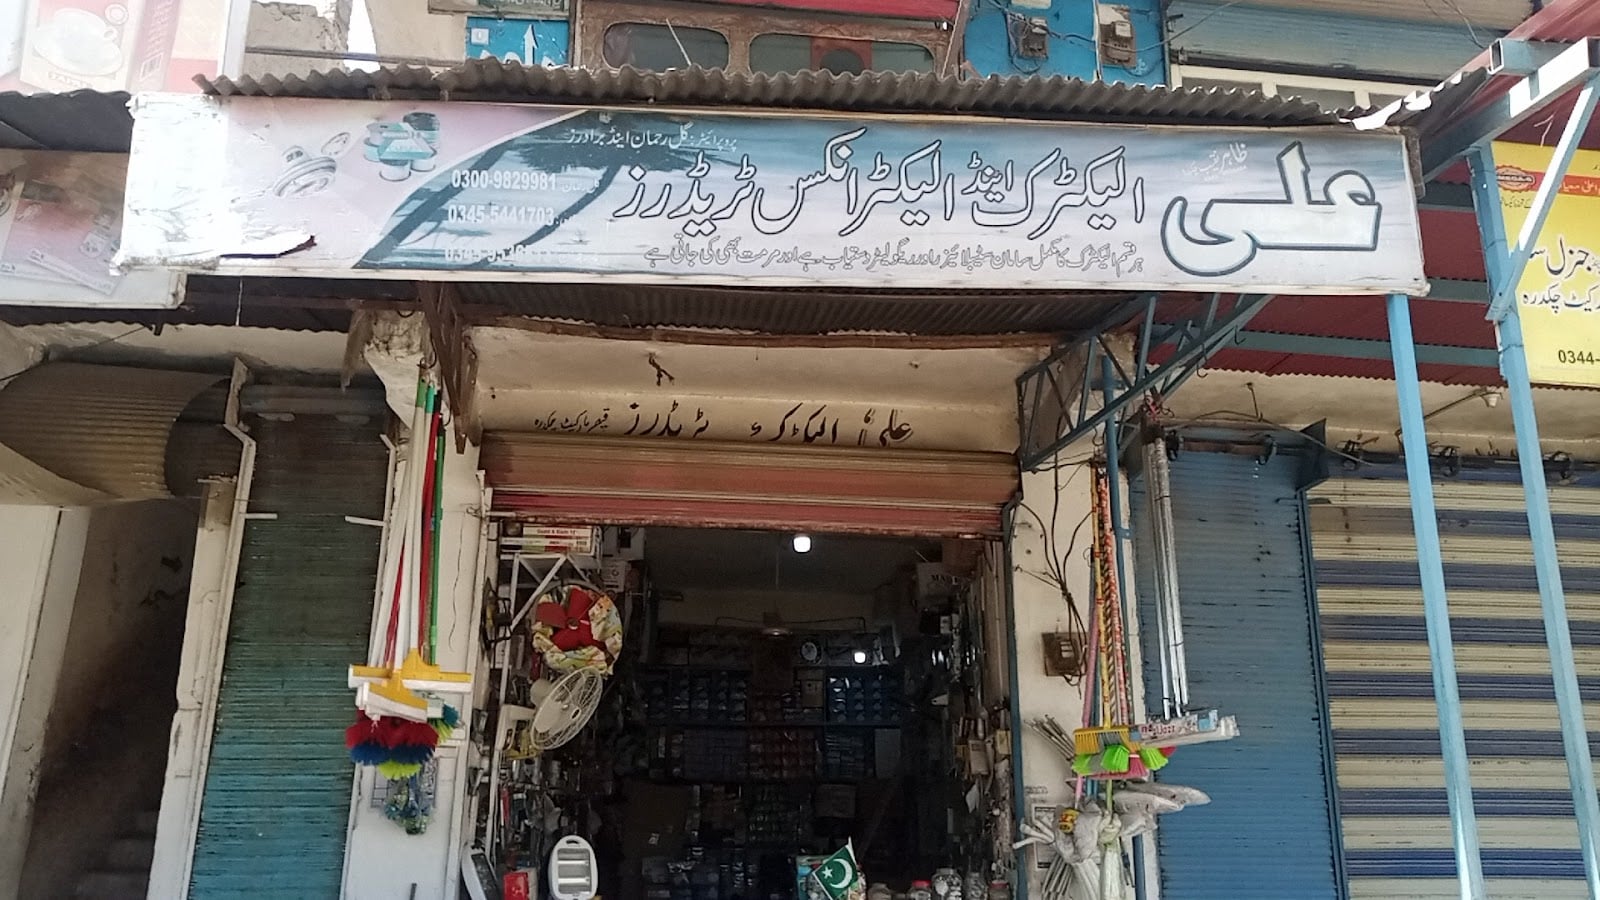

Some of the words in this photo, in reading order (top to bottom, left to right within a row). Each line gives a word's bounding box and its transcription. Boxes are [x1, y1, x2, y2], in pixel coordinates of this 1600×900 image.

[630, 129, 669, 149] رحمان
[669, 121, 694, 149] گل
[451, 169, 556, 191] 0300-9829981
[613, 150, 757, 237] ٹریڈرز
[751, 127, 955, 237] الیکٹرانکس
[961, 151, 1014, 202] اینڈ
[970, 146, 1146, 240] الیکٹرک
[1160, 140, 1383, 277] علی
[644, 247, 669, 268] ہے
[1546, 237, 1592, 278] جنرل
